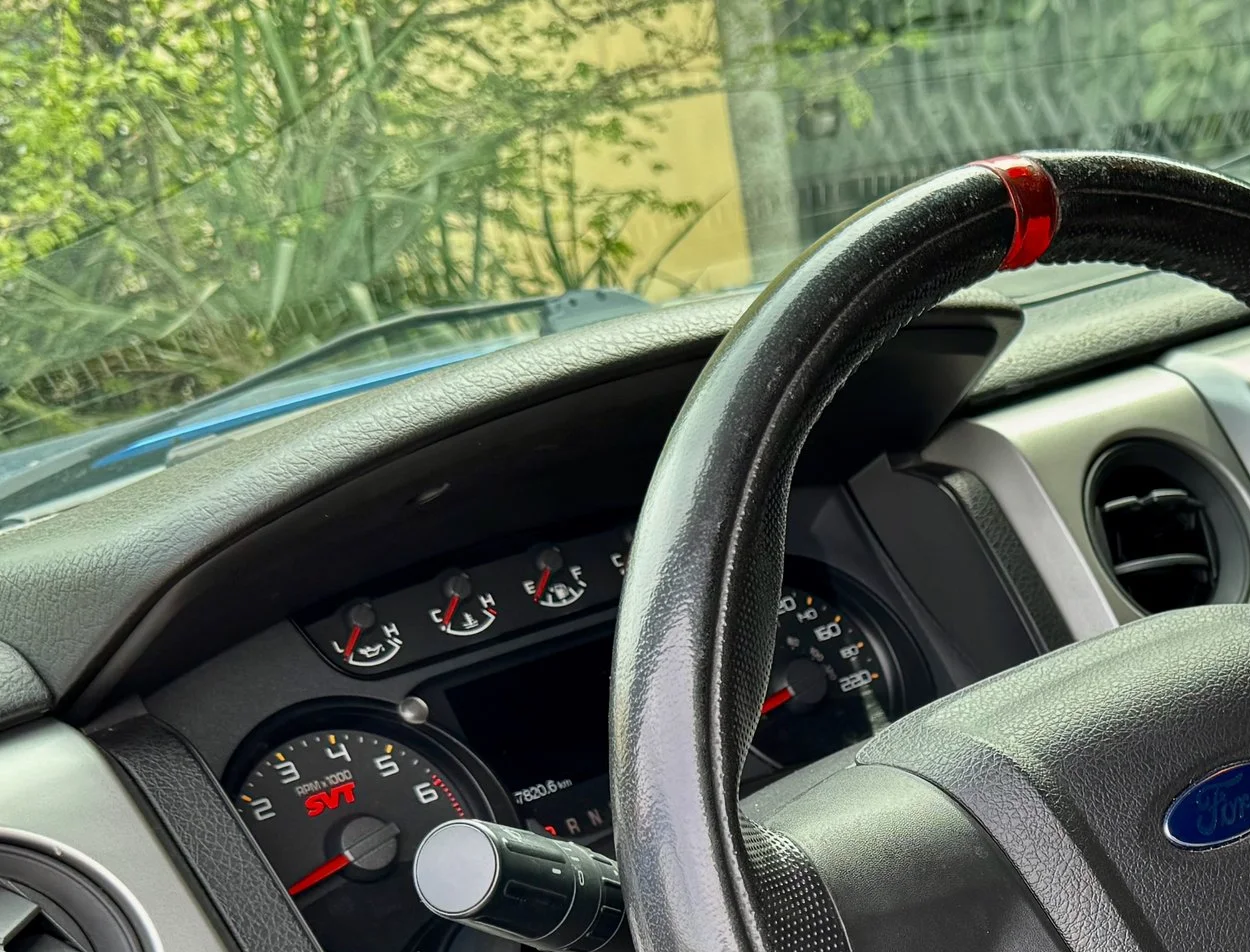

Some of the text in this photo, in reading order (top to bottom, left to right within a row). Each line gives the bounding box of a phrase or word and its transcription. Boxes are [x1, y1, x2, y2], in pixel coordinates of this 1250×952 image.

[523, 565, 583, 595] E F
[429, 593, 496, 623] C H
[332, 623, 398, 653] L H
[839, 669, 872, 692] 220
[326, 743, 351, 762] 4
[273, 761, 300, 784] 3
[373, 754, 400, 777] 5
[295, 780, 321, 797] RPM
[325, 769, 353, 785] 1000
[412, 782, 438, 804] 6
[251, 797, 276, 821] 2
[304, 781, 355, 817] SVT
[566, 817, 581, 835] R
[587, 808, 604, 827] N
